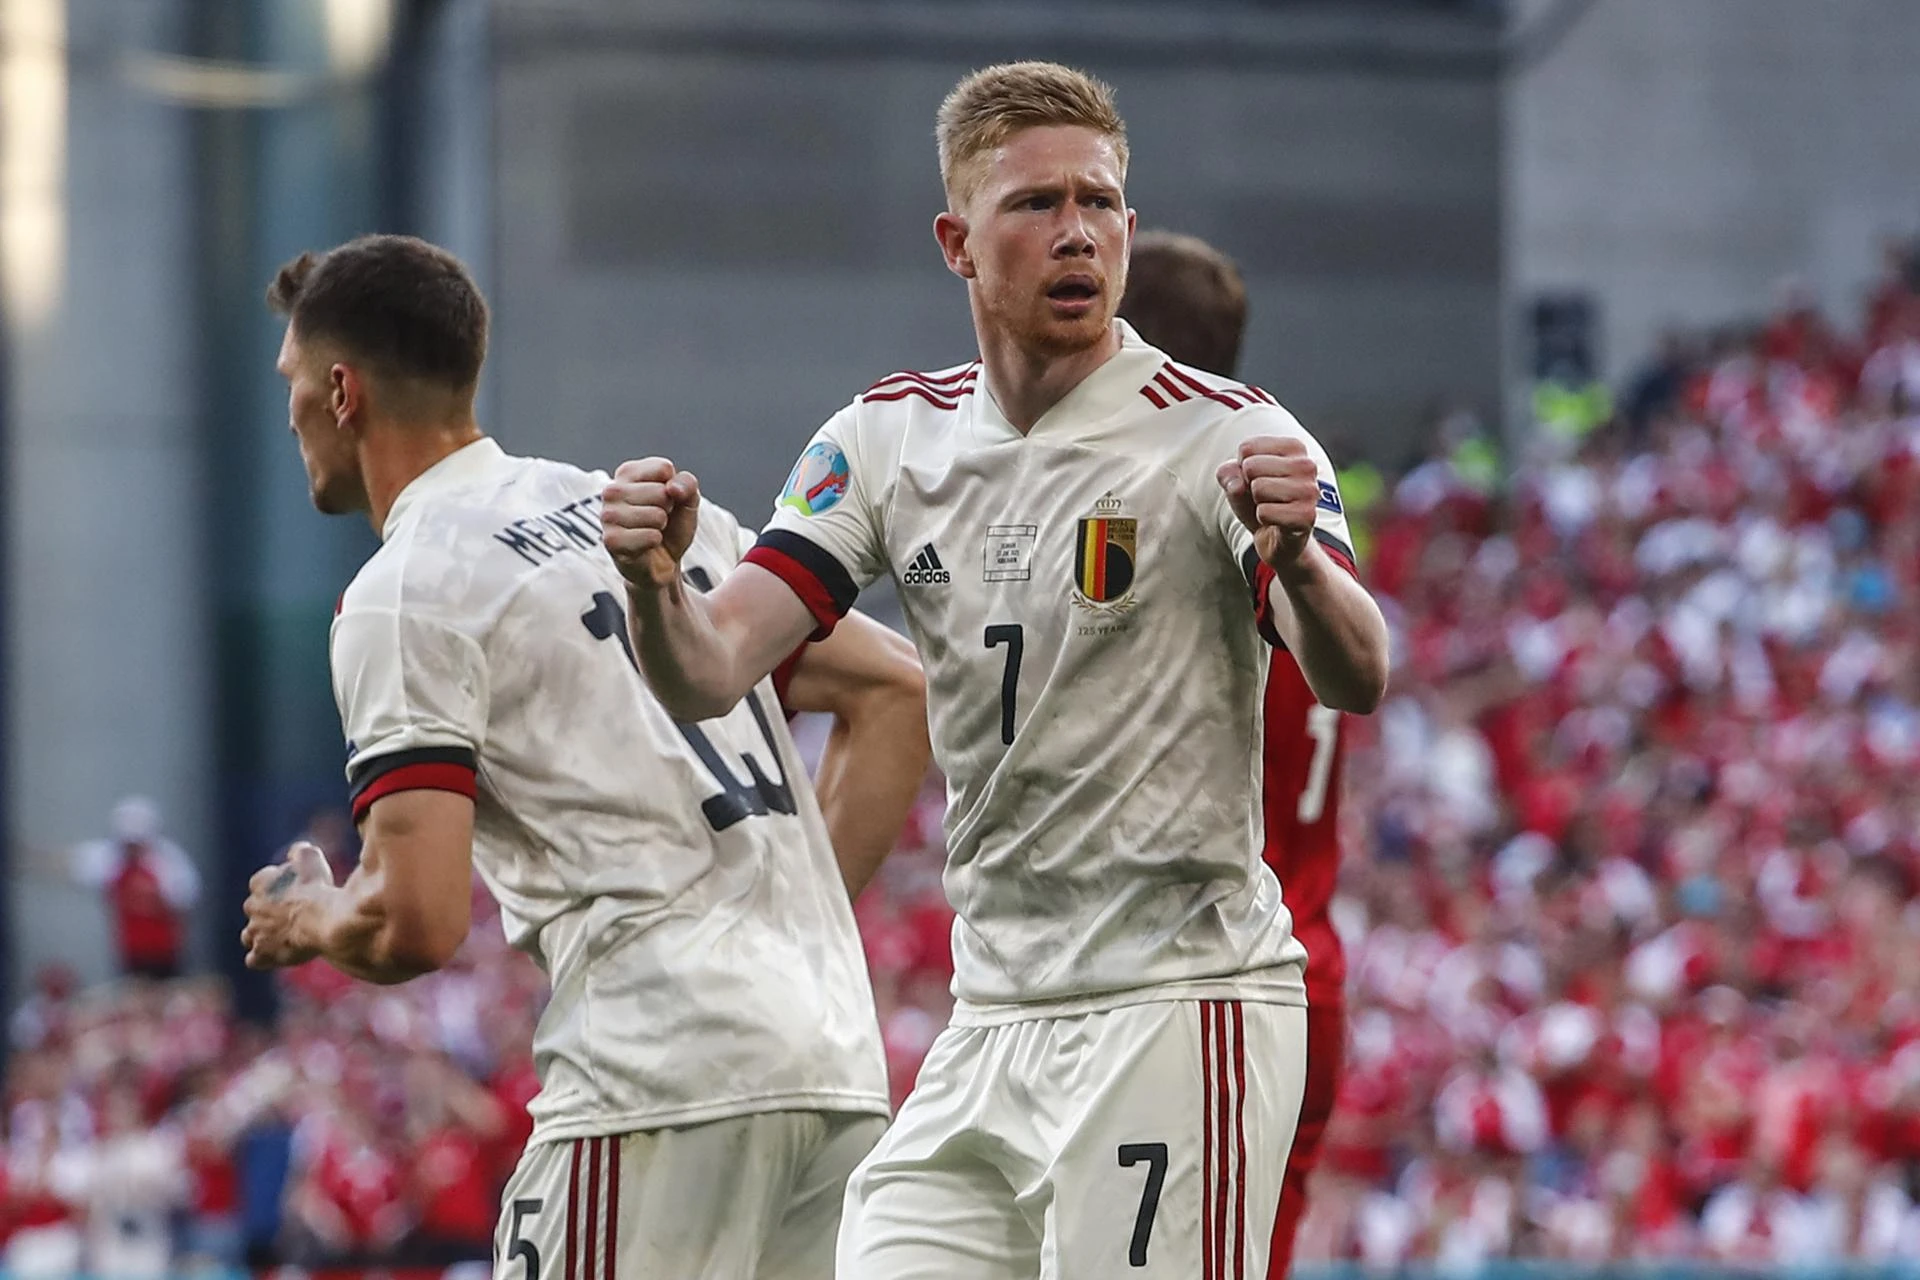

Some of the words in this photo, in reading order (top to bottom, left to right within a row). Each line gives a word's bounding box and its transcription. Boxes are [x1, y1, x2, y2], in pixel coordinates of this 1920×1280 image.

[903, 569, 951, 585] adidas
[984, 623, 1025, 746] 7
[507, 1198, 544, 1280] 5
[1117, 1142, 1169, 1267] 7
